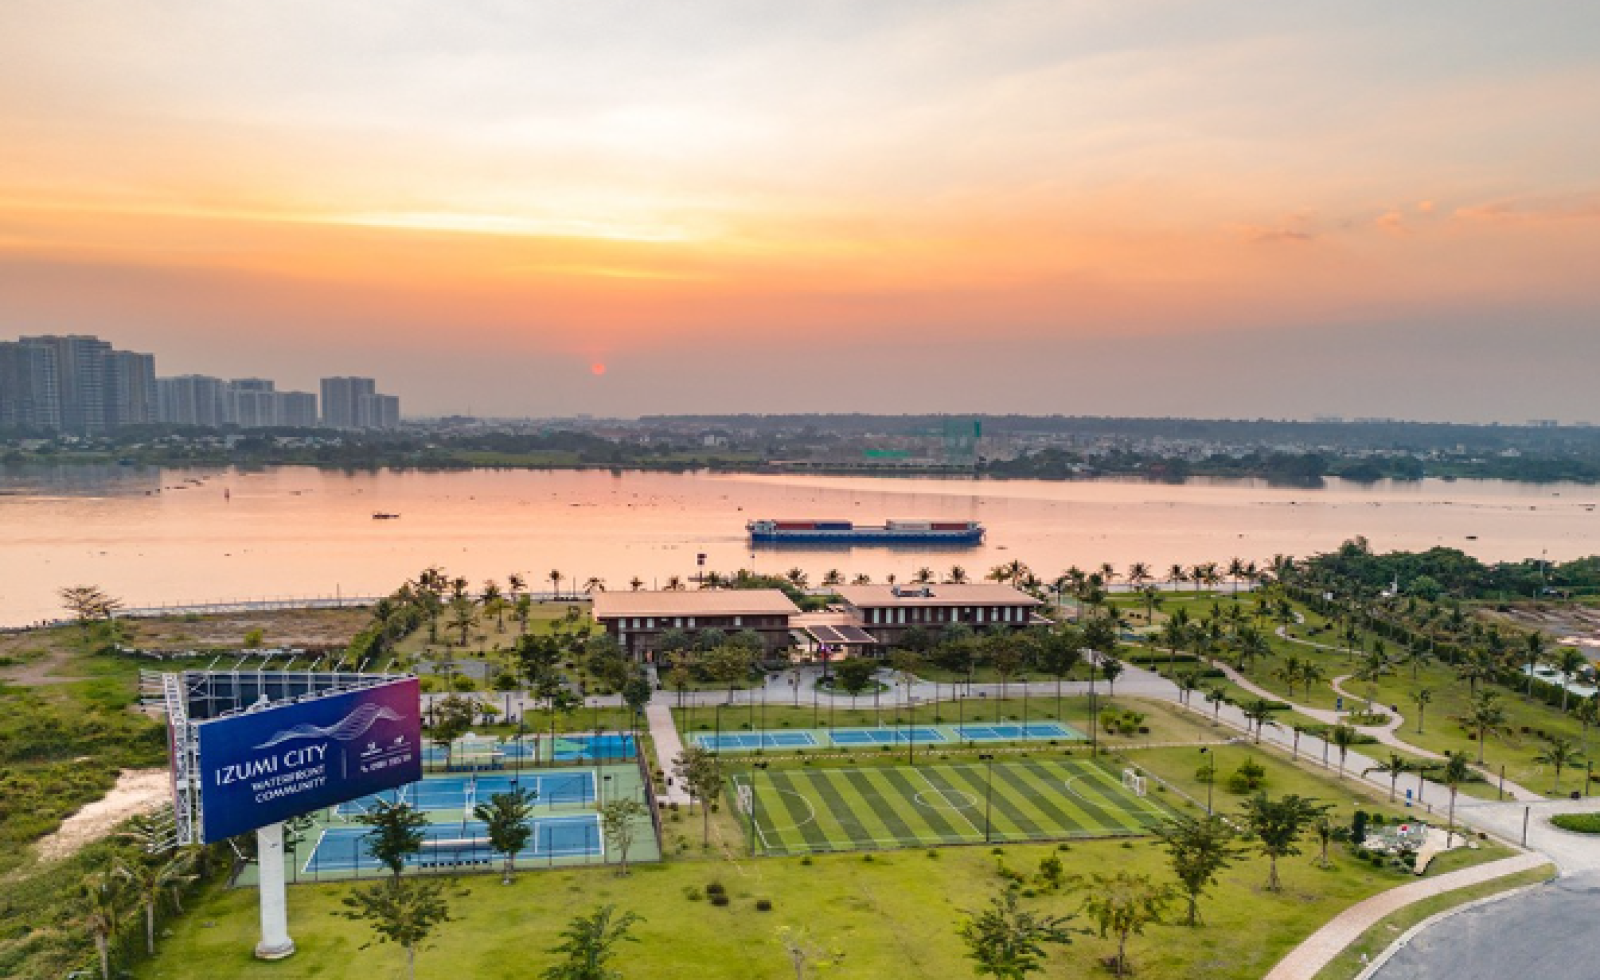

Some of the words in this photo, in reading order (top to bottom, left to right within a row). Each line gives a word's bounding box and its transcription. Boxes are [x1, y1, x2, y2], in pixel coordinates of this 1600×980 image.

[215, 754, 278, 786] IZUMI
[284, 743, 328, 768] CITY
[251, 764, 326, 791] WATERFRONT
[255, 776, 326, 804] COMMUNITY
